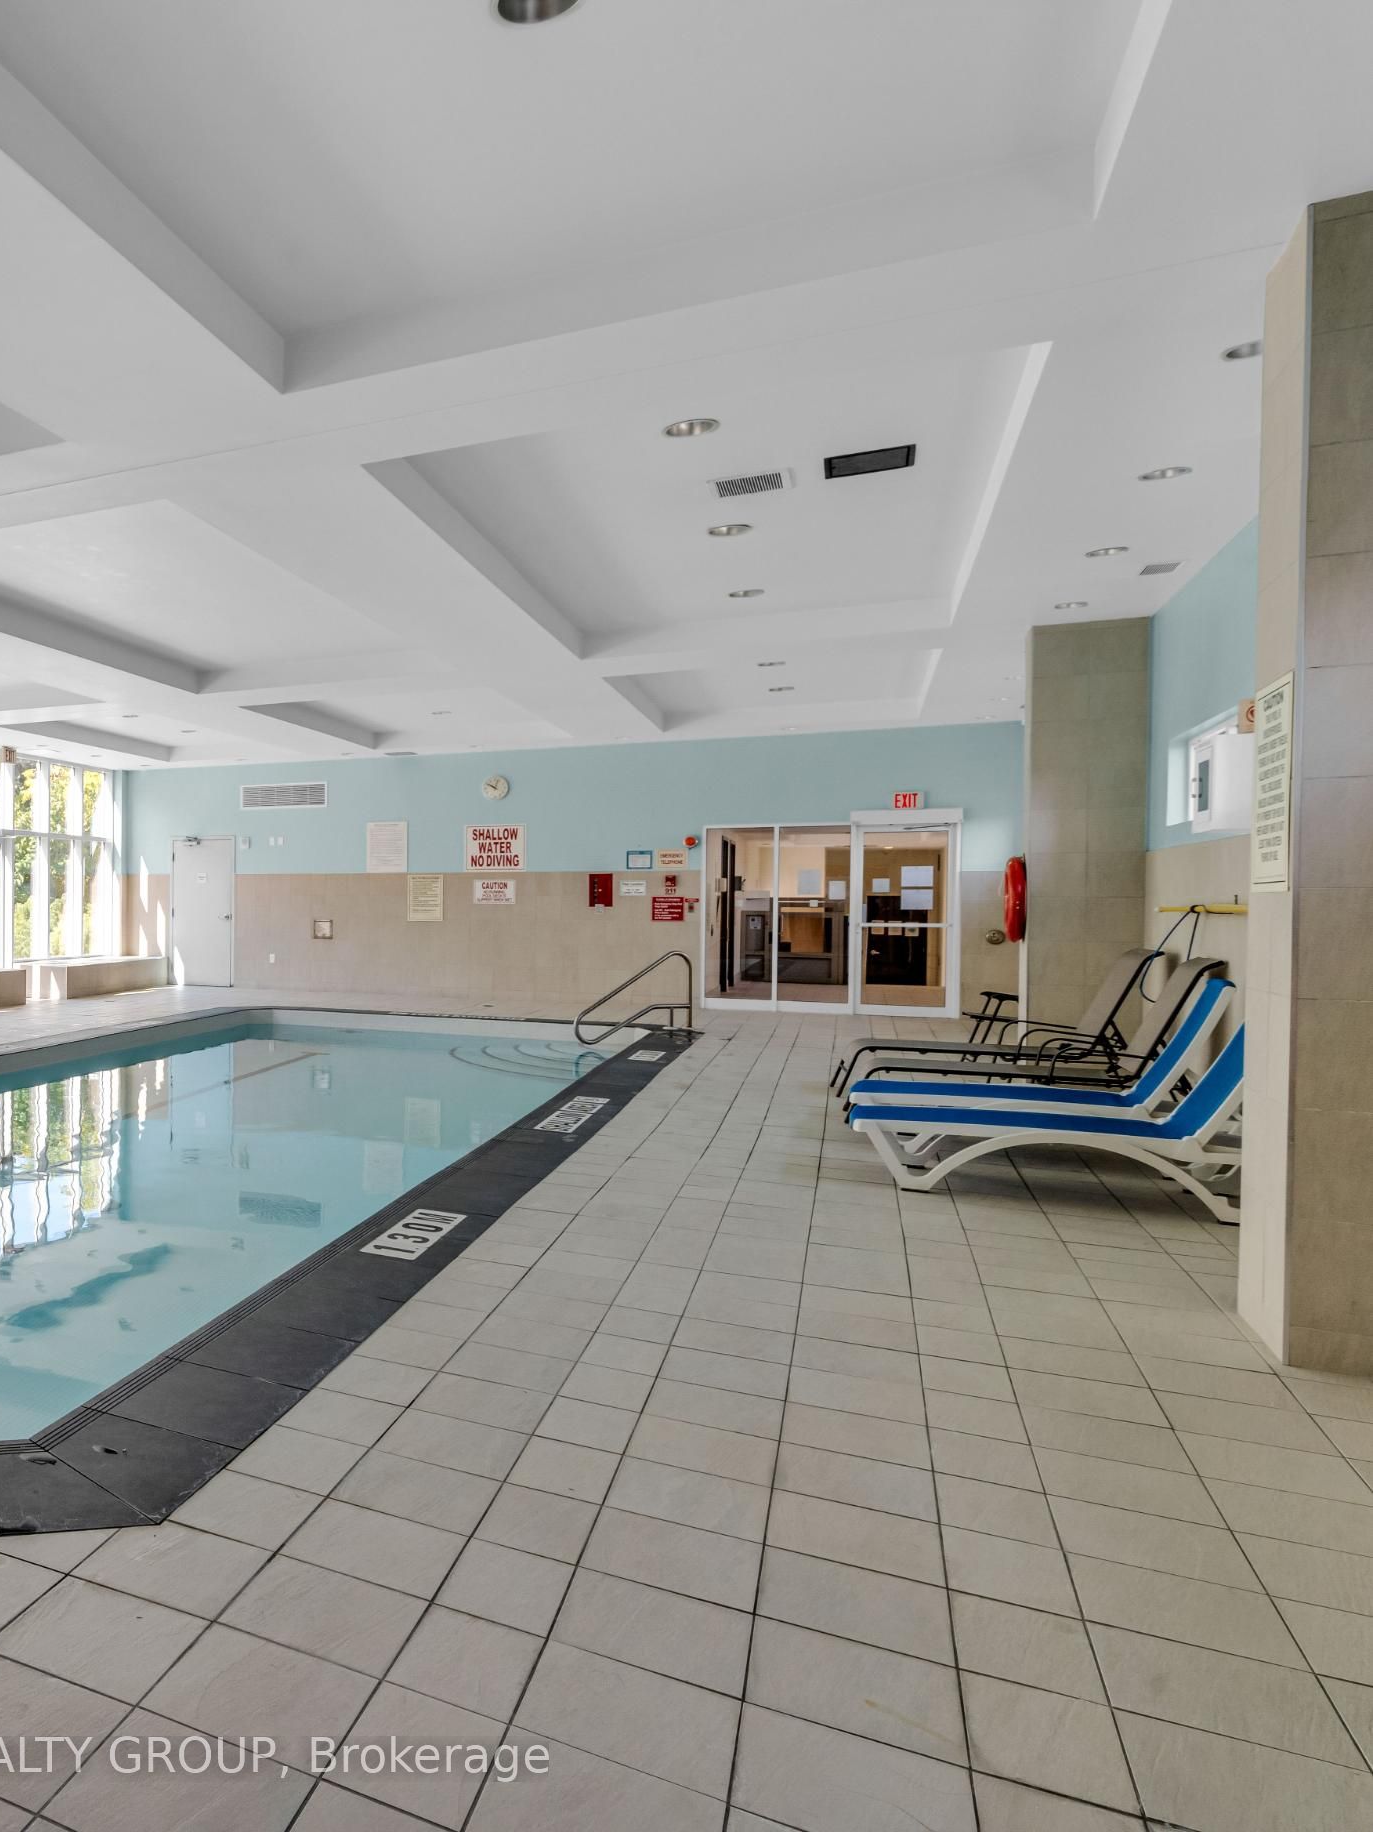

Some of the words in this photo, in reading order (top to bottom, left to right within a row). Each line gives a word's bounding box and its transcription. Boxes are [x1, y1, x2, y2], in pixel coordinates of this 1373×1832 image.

[894, 793, 918, 808] EXIT
[472, 828, 518, 841] SHALLOW
[478, 841, 512, 854] WATER
[470, 855, 485, 867] NO
[486, 854, 520, 867] DIVING
[481, 881, 508, 890] CAUTION
